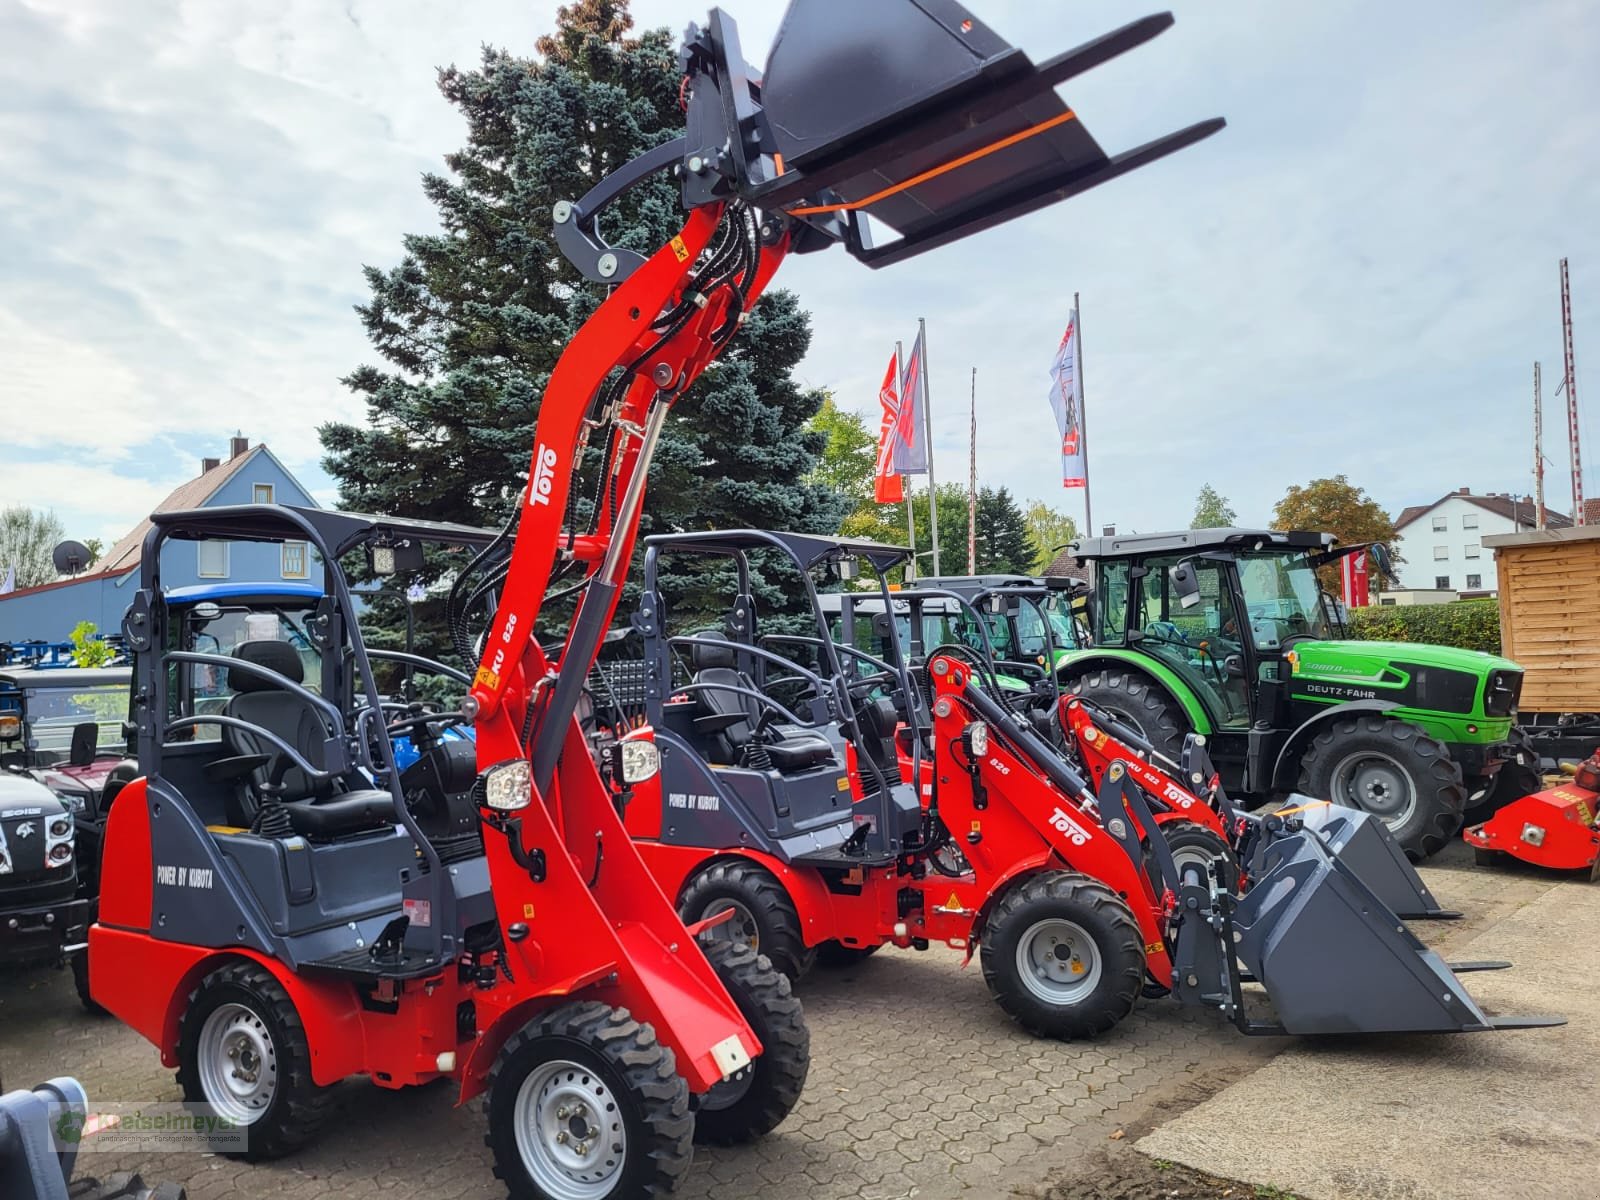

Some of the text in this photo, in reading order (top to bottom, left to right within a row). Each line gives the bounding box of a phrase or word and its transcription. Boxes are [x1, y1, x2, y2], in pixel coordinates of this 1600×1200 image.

[529, 443, 557, 506] TOYO
[491, 613, 518, 676] KU 826
[989, 758, 1011, 775] 826
[669, 793, 720, 811] POWER BY KUBOTA
[1163, 782, 1196, 809] TOYO
[1048, 807, 1093, 846] TOYO
[157, 865, 213, 889] POWER BY KUBOTA
